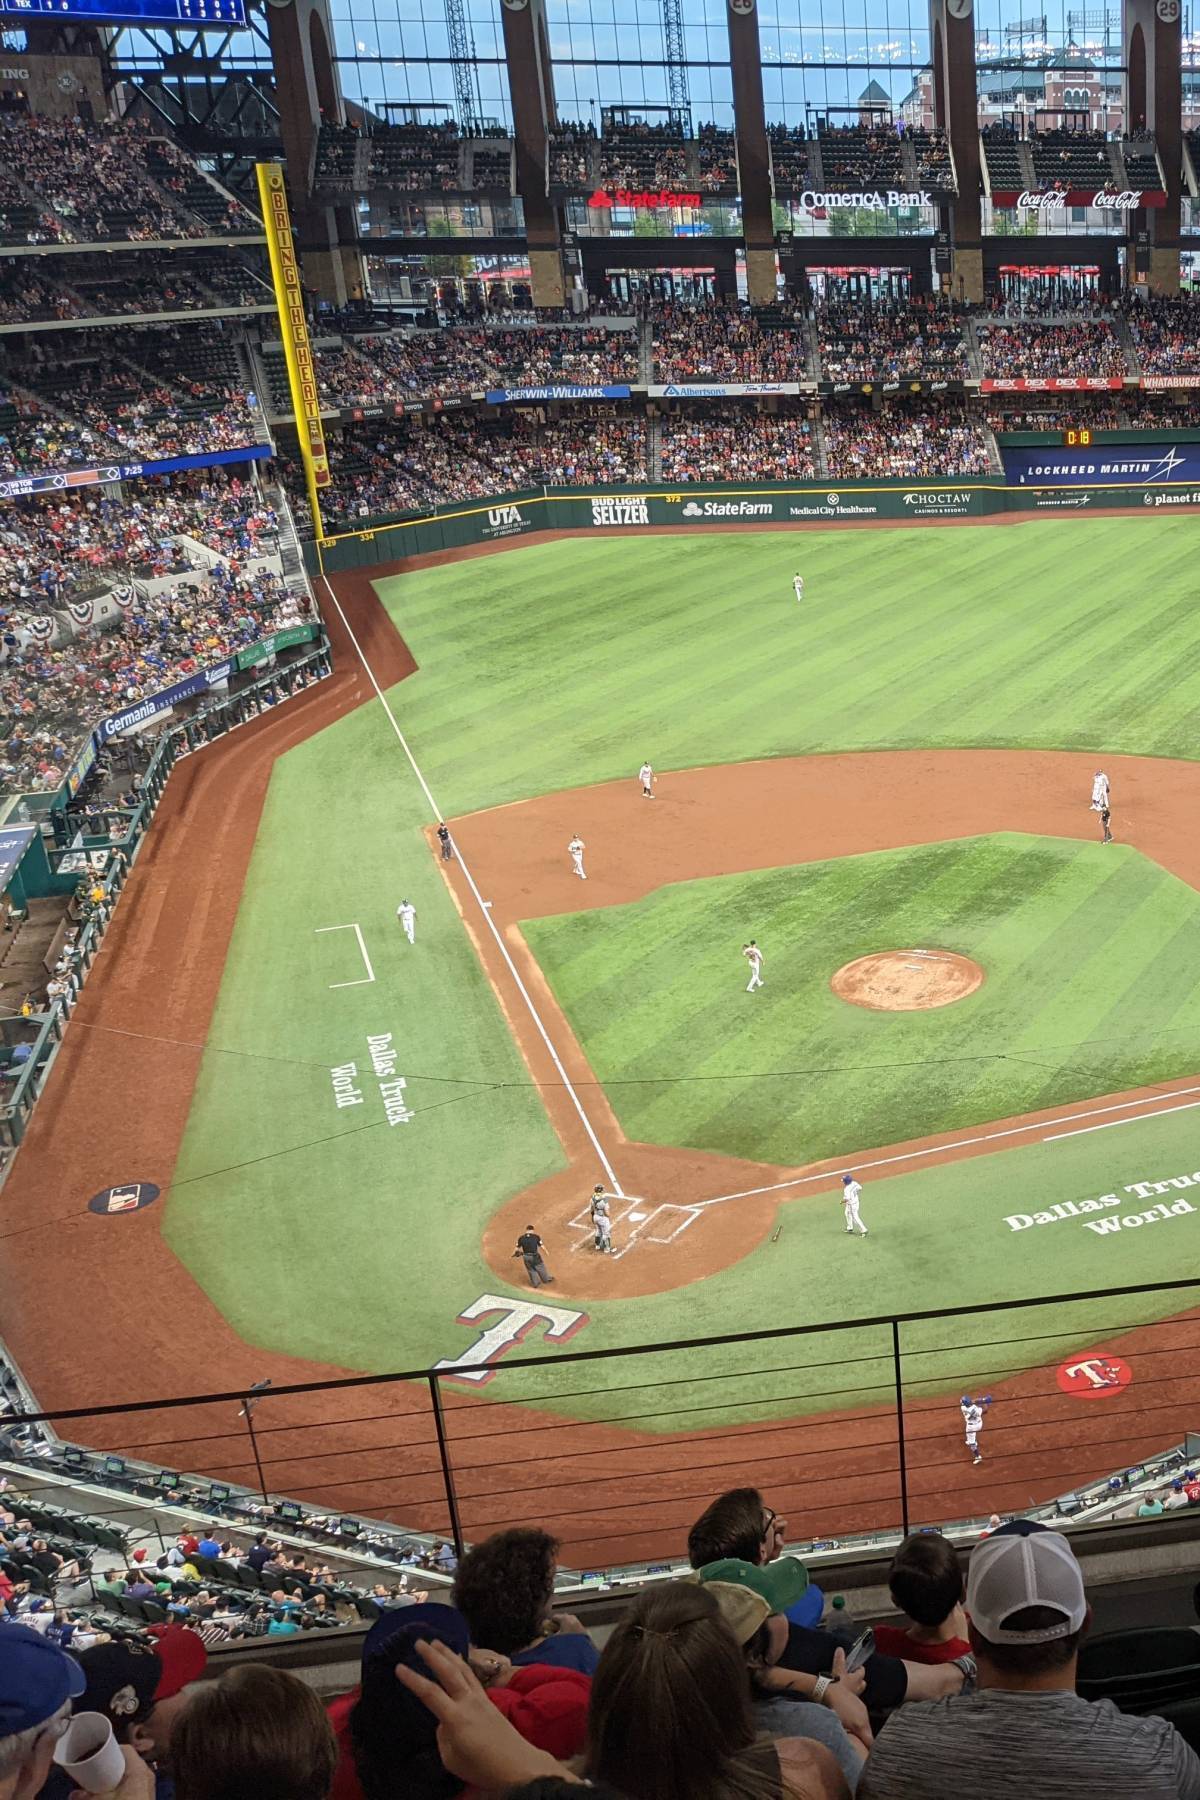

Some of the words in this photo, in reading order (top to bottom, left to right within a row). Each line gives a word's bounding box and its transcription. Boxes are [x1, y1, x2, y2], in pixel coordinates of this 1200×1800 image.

[1160, 2, 1177, 16] 29
[887, 191, 932, 207] Bank
[1017, 190, 1068, 209] Coca-Cola
[1092, 190, 1143, 209] Coca-Cola
[272, 192, 297, 285] BRING
[286, 288, 306, 343] THE
[296, 347, 318, 417] HEAT
[680, 385, 727, 397] Albertsons
[759, 384, 784, 393] Thumb
[124, 466, 143, 476] 7:25
[1028, 464, 1095, 476] LOCKHEED
[1101, 462, 1150, 475] MARTIN
[592, 497, 614, 506] BUD
[615, 497, 647, 505] LIGHT
[665, 494, 681, 503] 372
[911, 493, 972, 504] CHOCTAW
[1155, 492, 1190, 505] planet
[487, 505, 523, 526] UTA
[592, 505, 649, 525] SELTZER
[790, 507, 819, 515] Medical
[819, 506, 836, 516] City
[836, 505, 877, 515] Healthcare
[105, 700, 156, 735] Germania
[156, 685, 197, 710] INSURANCE
[366, 1032, 398, 1077] Dallas
[330, 1062, 364, 1108] World
[379, 1077, 416, 1126] Truck
[1002, 1193, 1121, 1232] Dallas
[1082, 1198, 1198, 1235] World
